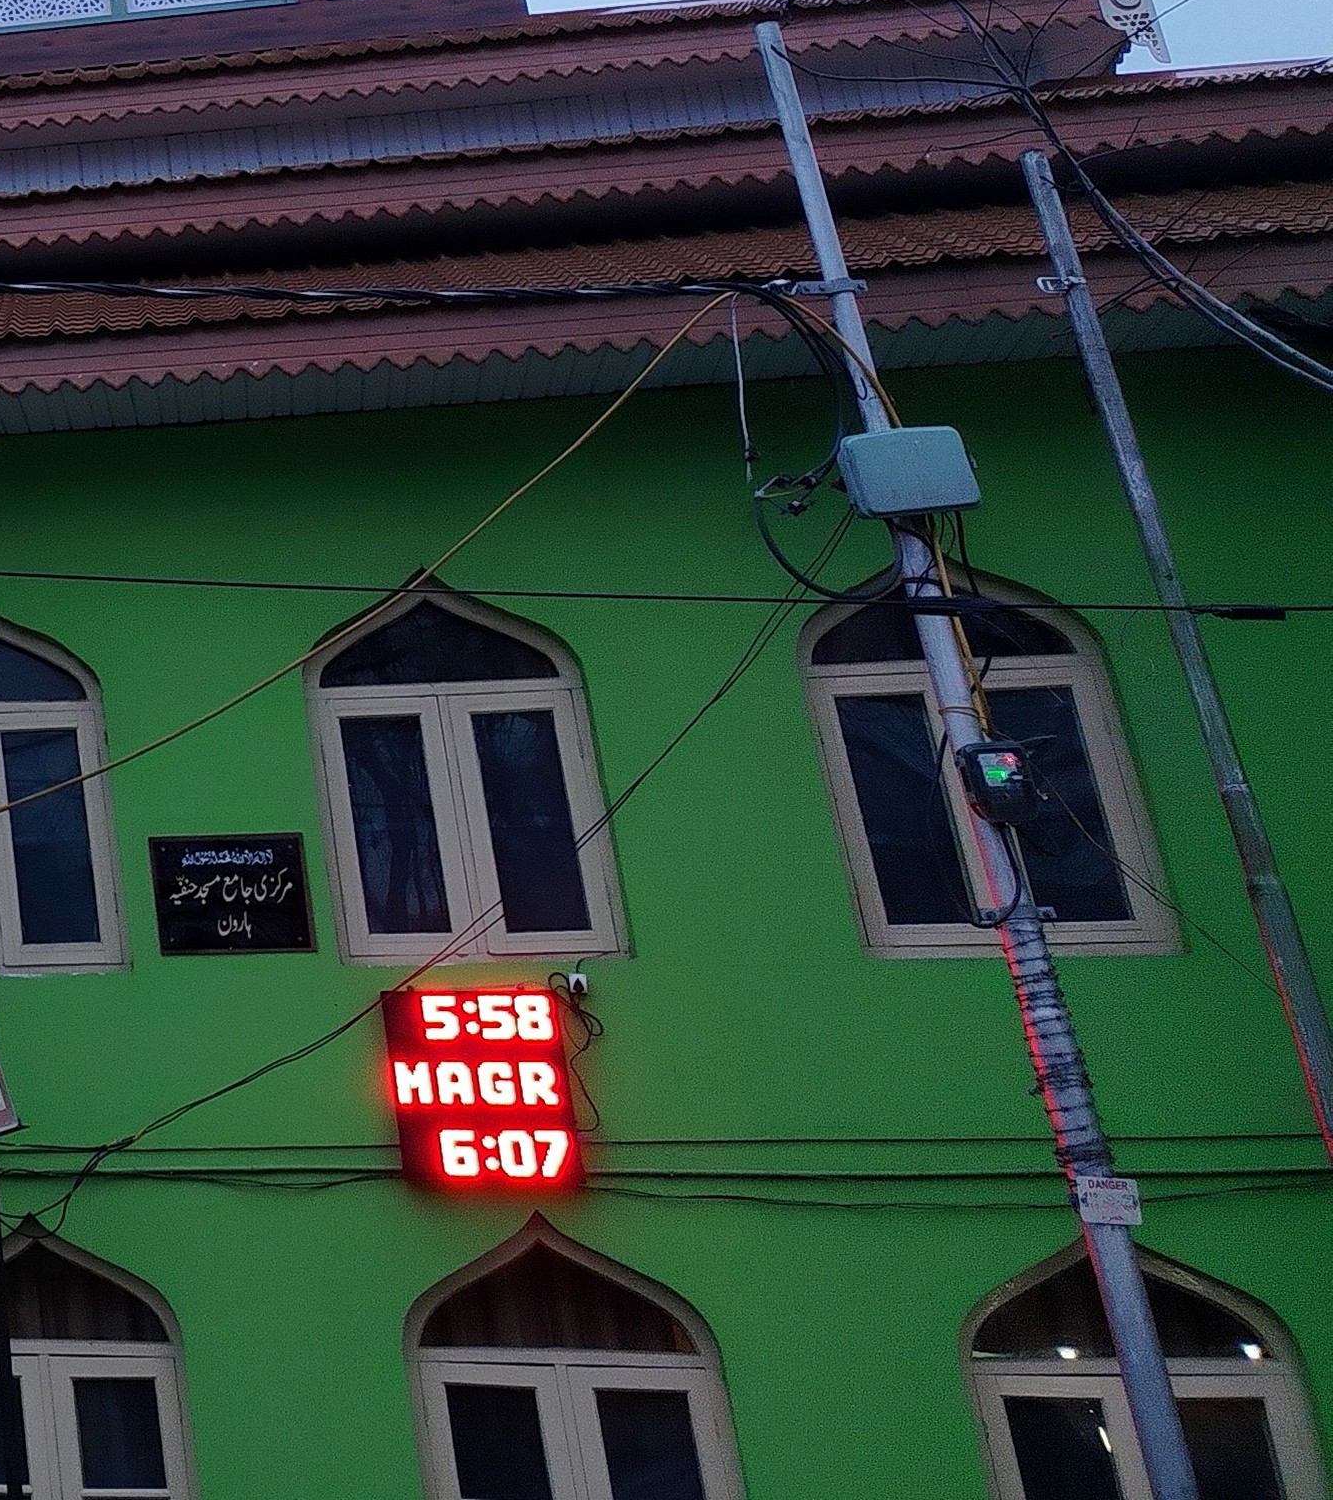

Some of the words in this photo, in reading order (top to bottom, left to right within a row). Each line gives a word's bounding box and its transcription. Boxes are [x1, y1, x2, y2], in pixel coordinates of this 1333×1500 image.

[420, 995, 554, 1040] 5:58
[393, 1061, 559, 1105] MAGR
[438, 1128, 569, 1178] 6:07
[1087, 1179, 1129, 1191] DANGER
